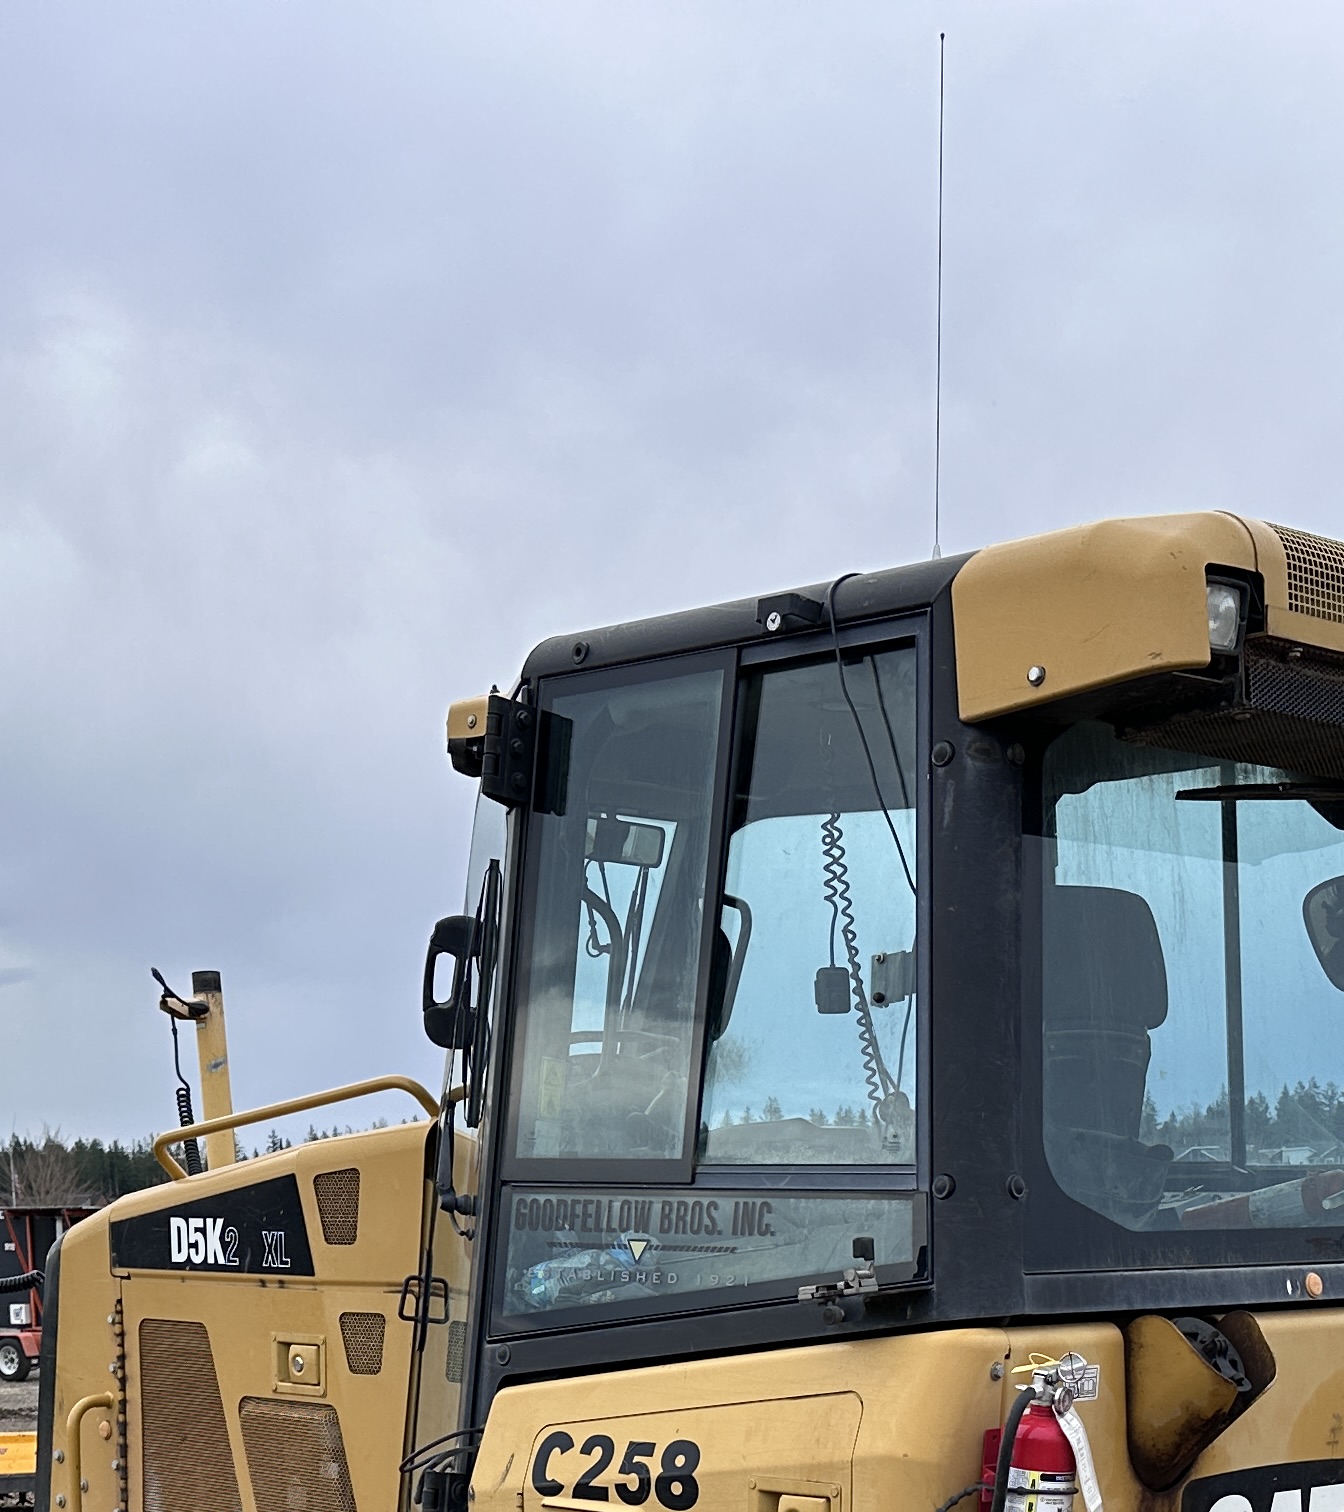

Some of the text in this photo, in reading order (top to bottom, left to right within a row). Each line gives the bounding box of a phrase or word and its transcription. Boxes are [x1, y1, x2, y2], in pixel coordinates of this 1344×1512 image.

[514, 1197, 777, 1237] GOODFELLOW BROS. INC.
[262, 1230, 292, 1269] XL
[525, 1266, 749, 1287] ESTABLISHED 1921
[532, 1431, 702, 1512] C258
